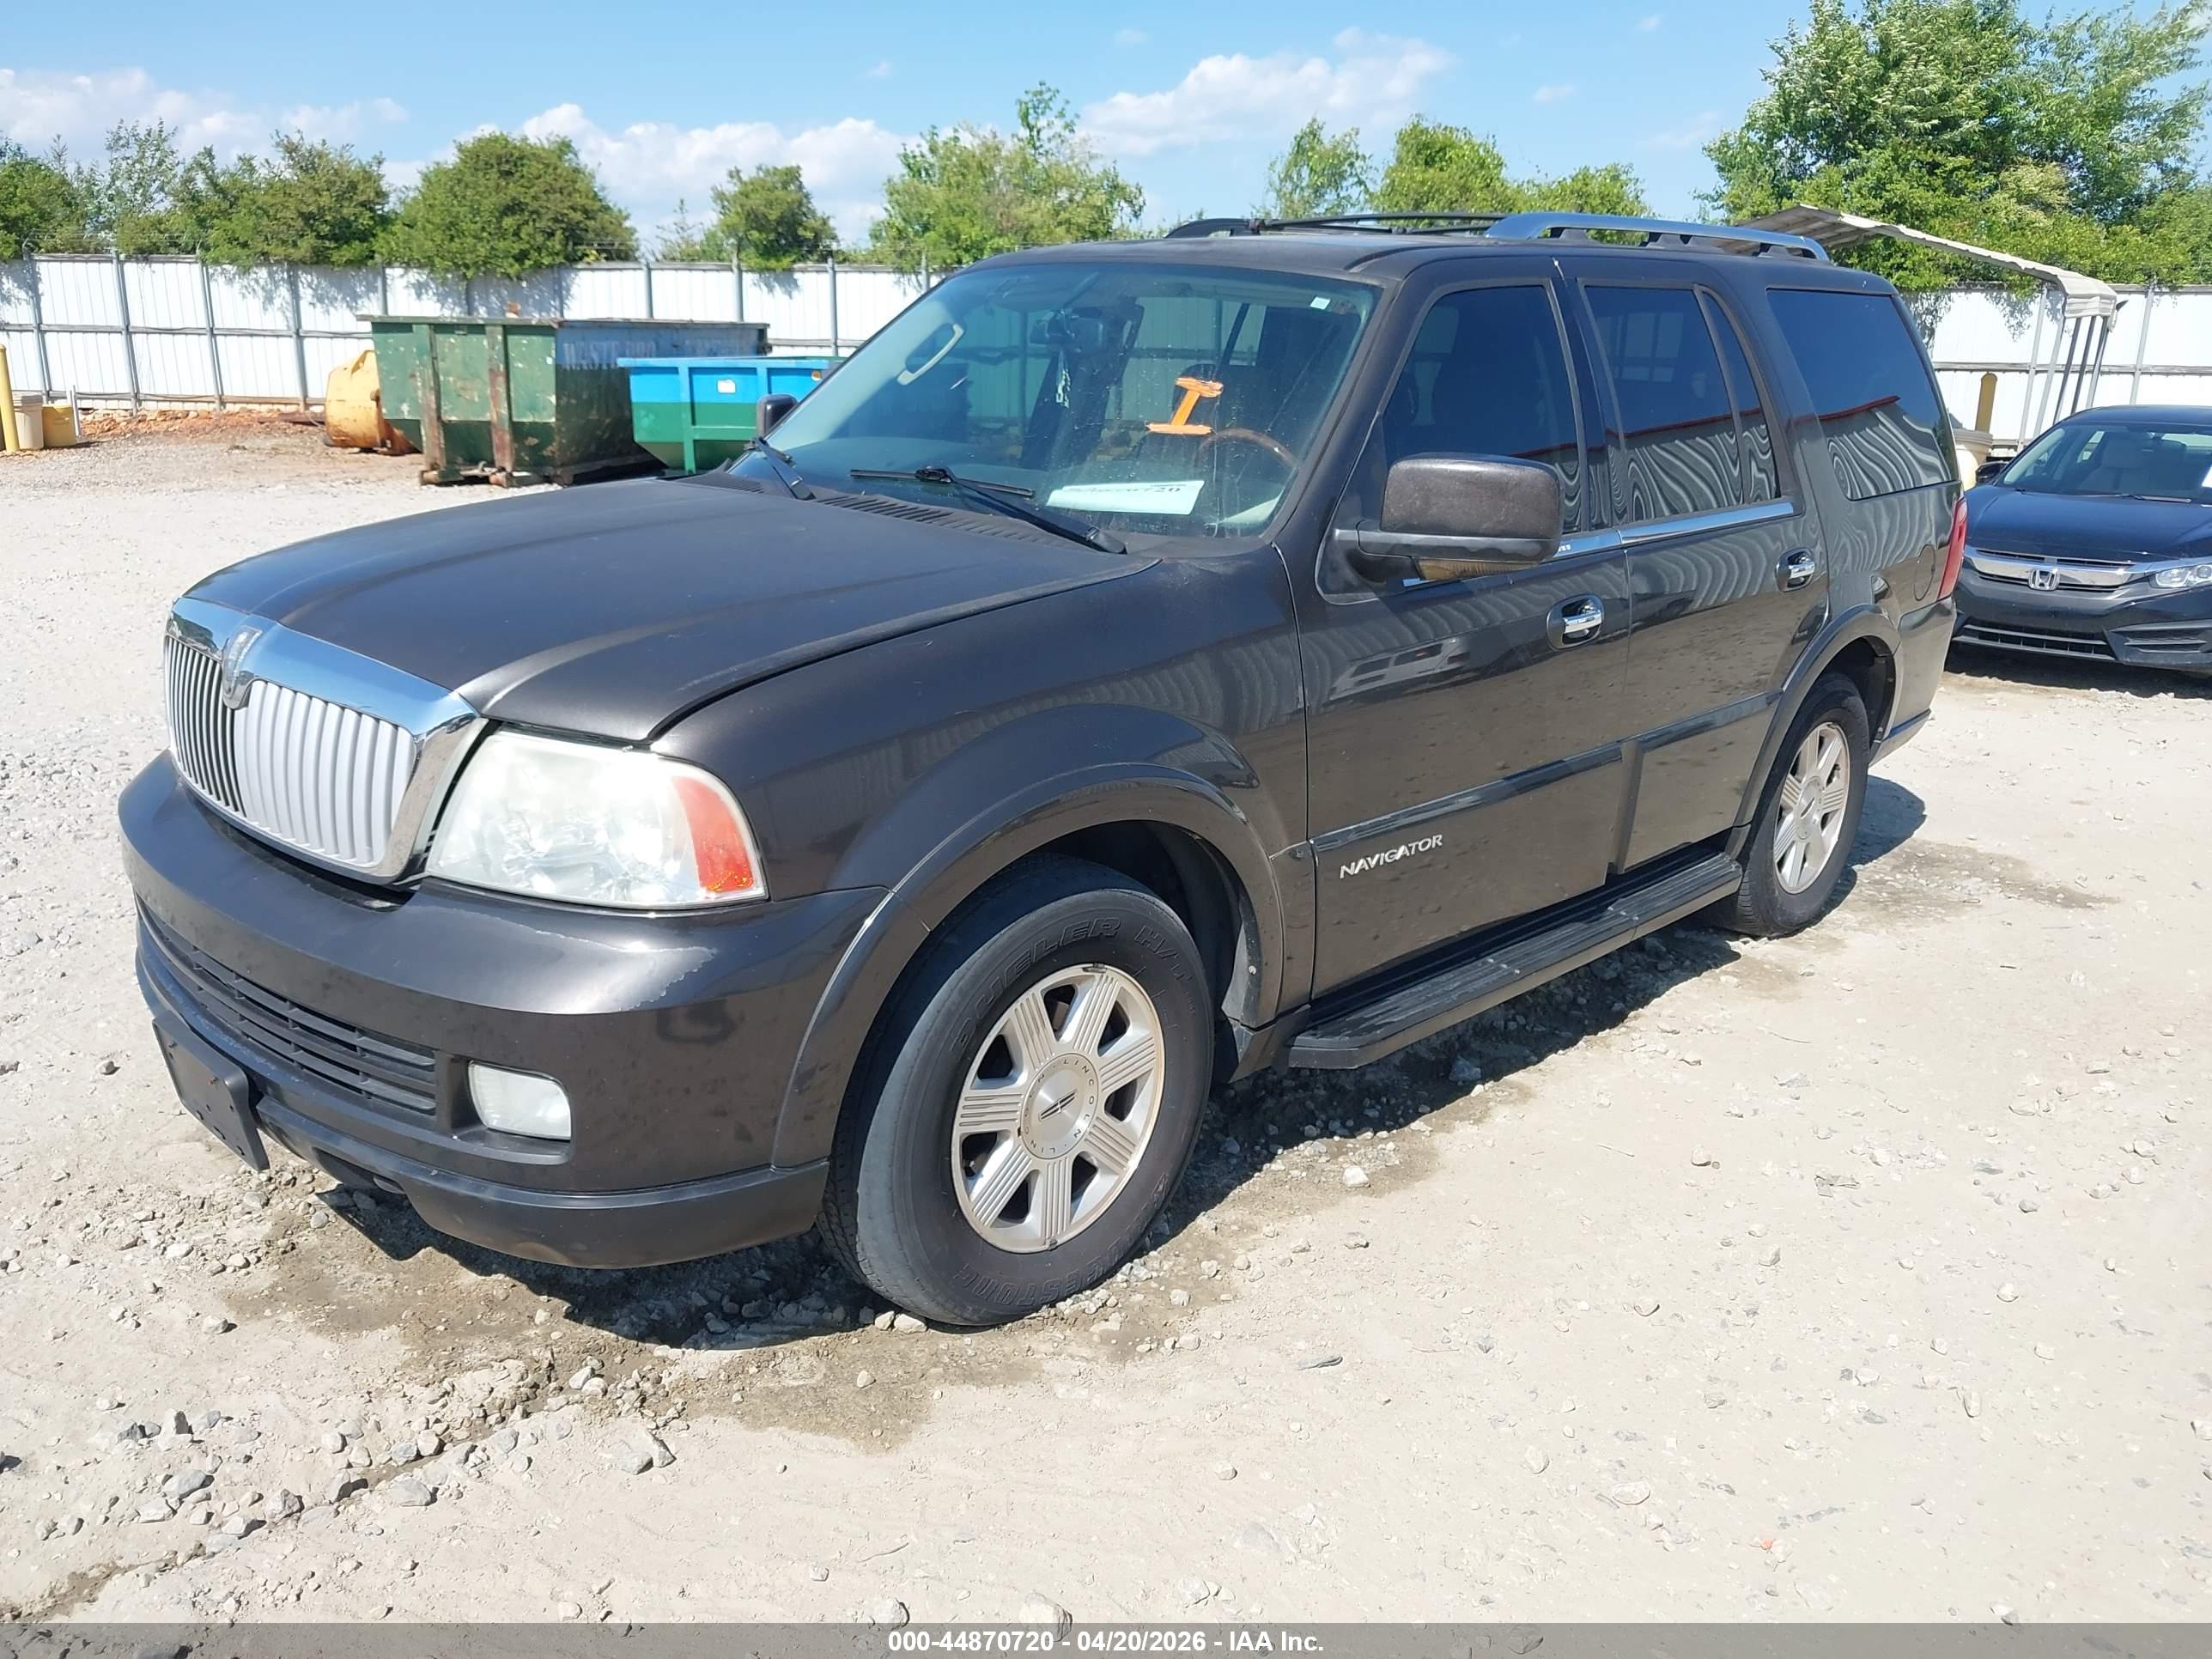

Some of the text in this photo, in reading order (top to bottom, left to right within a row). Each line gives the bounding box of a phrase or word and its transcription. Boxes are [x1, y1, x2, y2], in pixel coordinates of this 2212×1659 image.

[562, 341, 618, 370] WASTE
[1340, 834, 1443, 879] NAVIGATOR
[950, 916, 1121, 1058] DUELER
[1063, 1059, 1095, 1139] LINCOLN
[952, 1173, 1169, 1306] BDGESTONE
